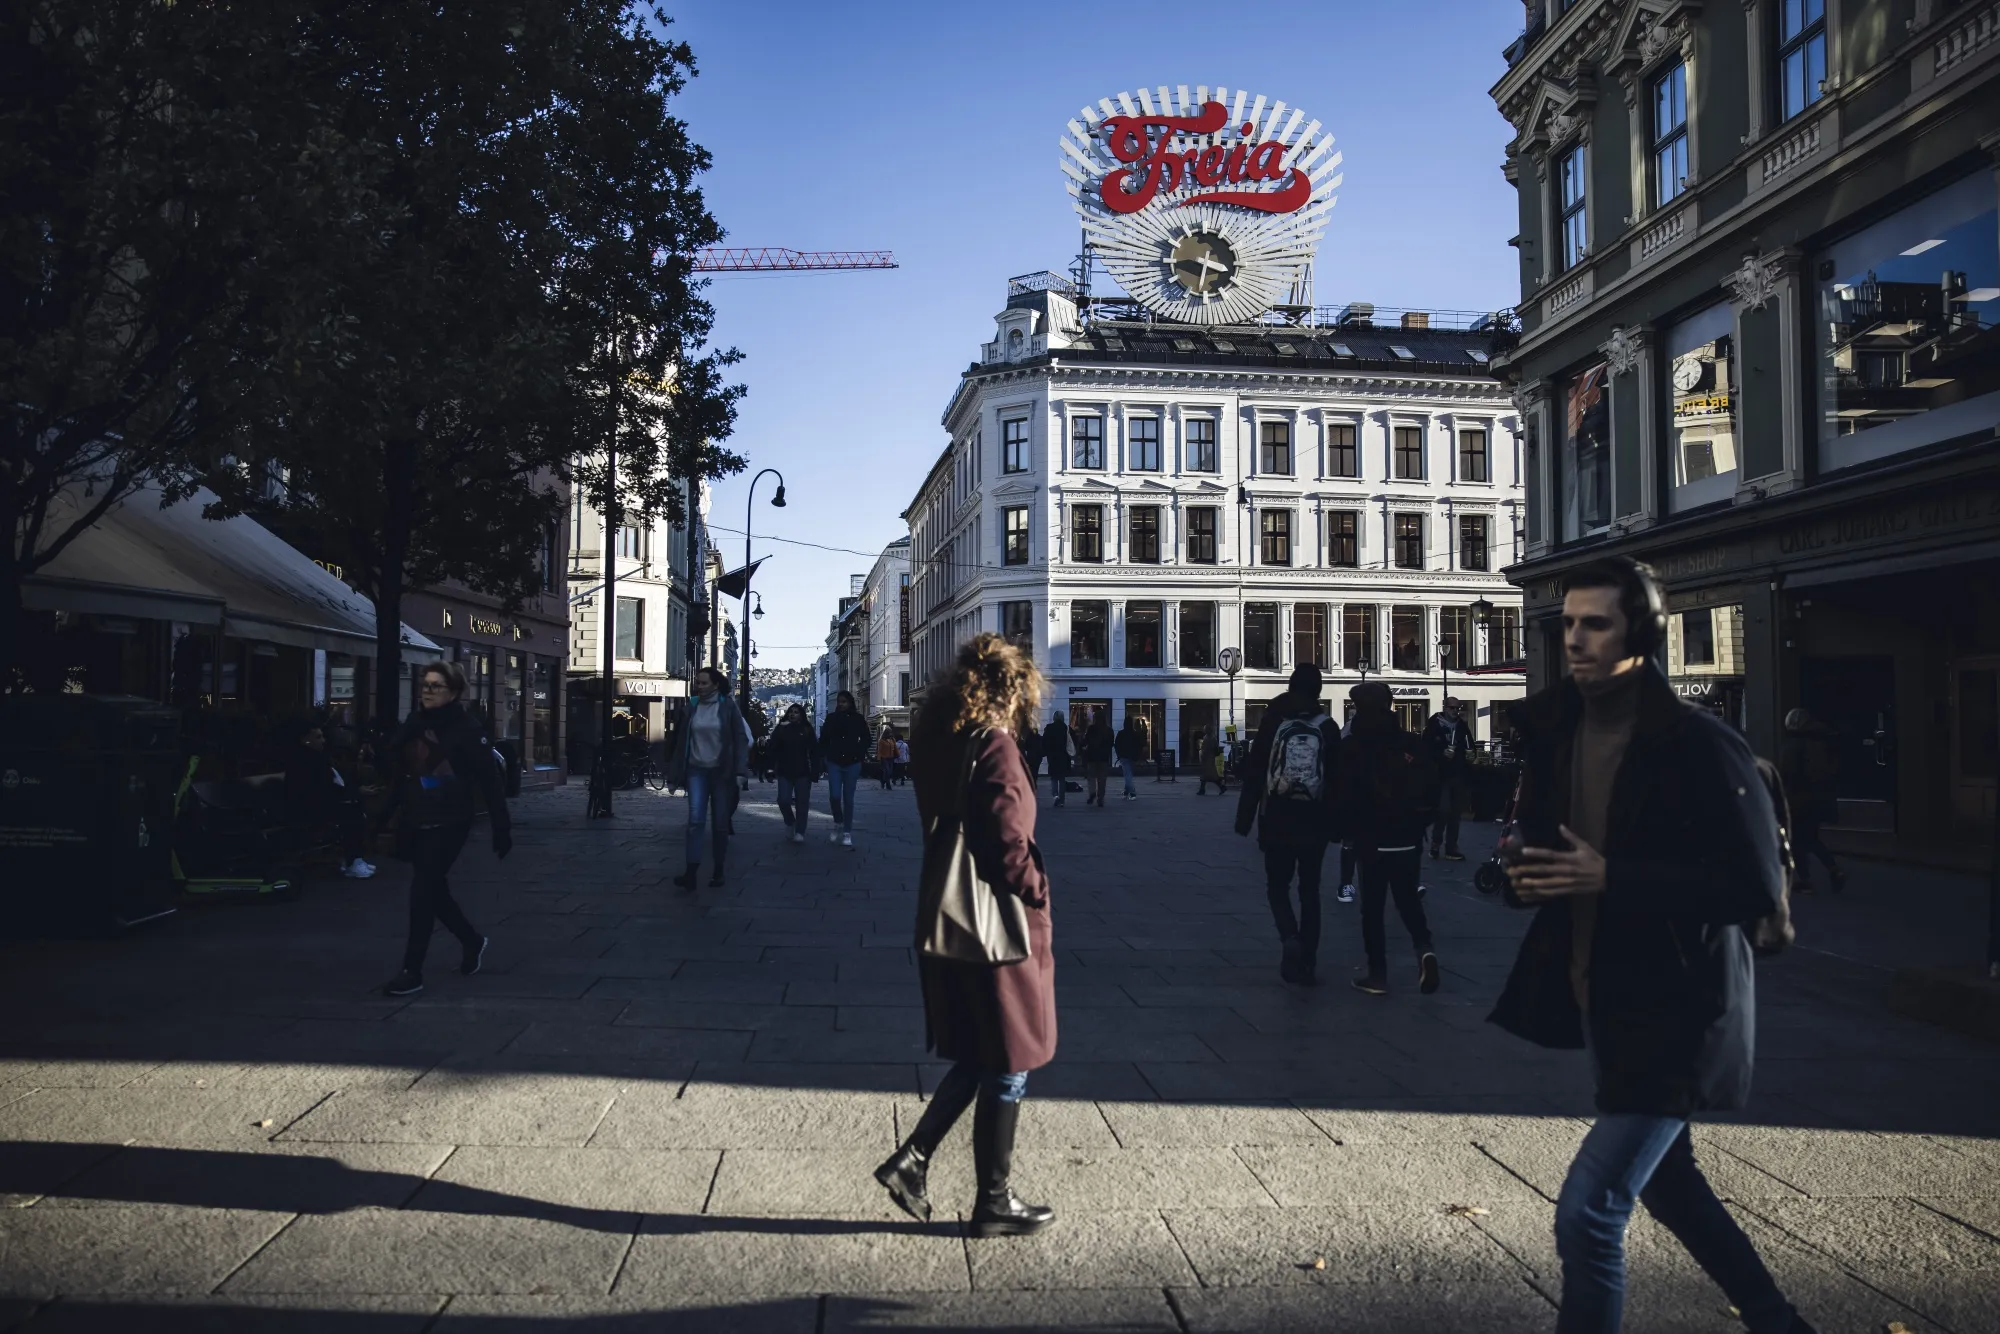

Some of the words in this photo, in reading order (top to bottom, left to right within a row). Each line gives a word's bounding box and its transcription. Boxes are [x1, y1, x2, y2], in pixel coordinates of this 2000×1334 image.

[1100, 101, 1311, 214] Freia
[1779, 523, 1825, 554] CARL
[1688, 547, 1727, 574] SHOP
[625, 681, 660, 694] VOLT
[1390, 687, 1430, 696] ZARA
